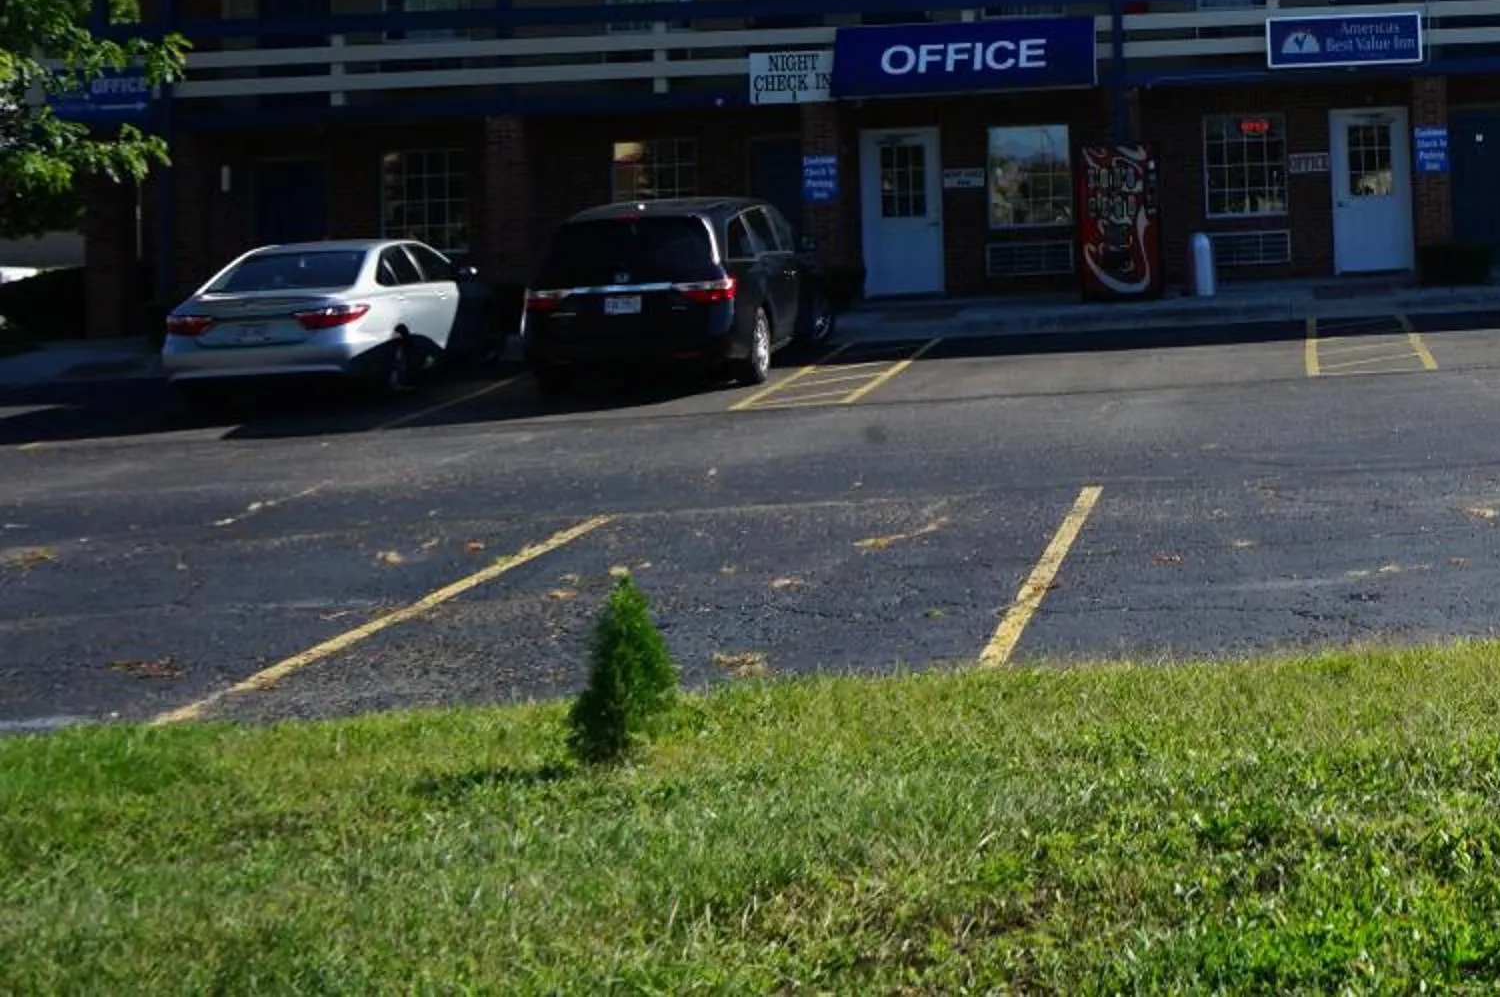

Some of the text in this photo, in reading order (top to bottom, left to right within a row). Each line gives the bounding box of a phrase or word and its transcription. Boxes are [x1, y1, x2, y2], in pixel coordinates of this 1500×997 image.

[1324, 34, 1416, 52] Best Value Inn
[768, 53, 819, 72] NIGHT
[881, 38, 1047, 75] OFFICE
[753, 73, 832, 92] CHECK IN
